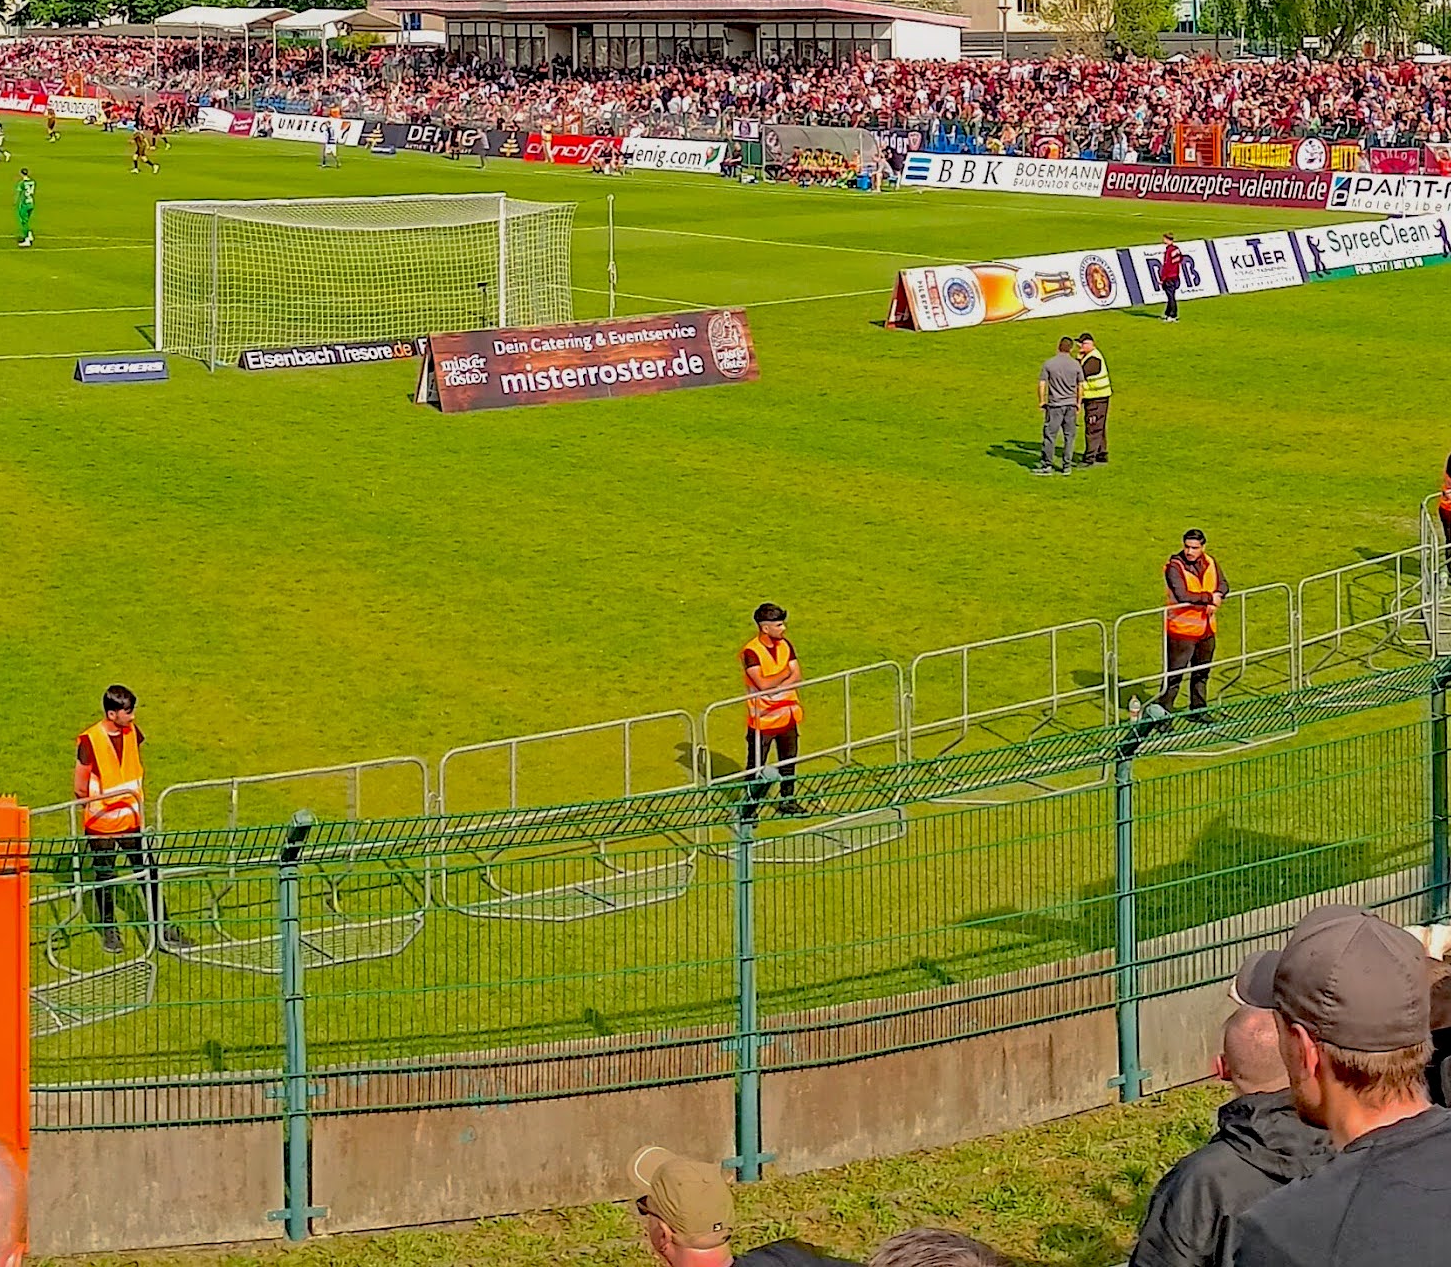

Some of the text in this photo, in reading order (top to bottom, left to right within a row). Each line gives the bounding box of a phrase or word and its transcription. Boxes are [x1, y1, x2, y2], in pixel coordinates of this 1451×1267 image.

[1015, 162, 1104, 183] BOERMANN
[1105, 169, 1328, 202] energiekonzepte-valentin.de
[1325, 221, 1432, 253] SpreeClean
[493, 322, 698, 355] Dein Catering & Eventservice
[84, 362, 165, 376] SKECHERS
[500, 349, 705, 394] misterroster.de
